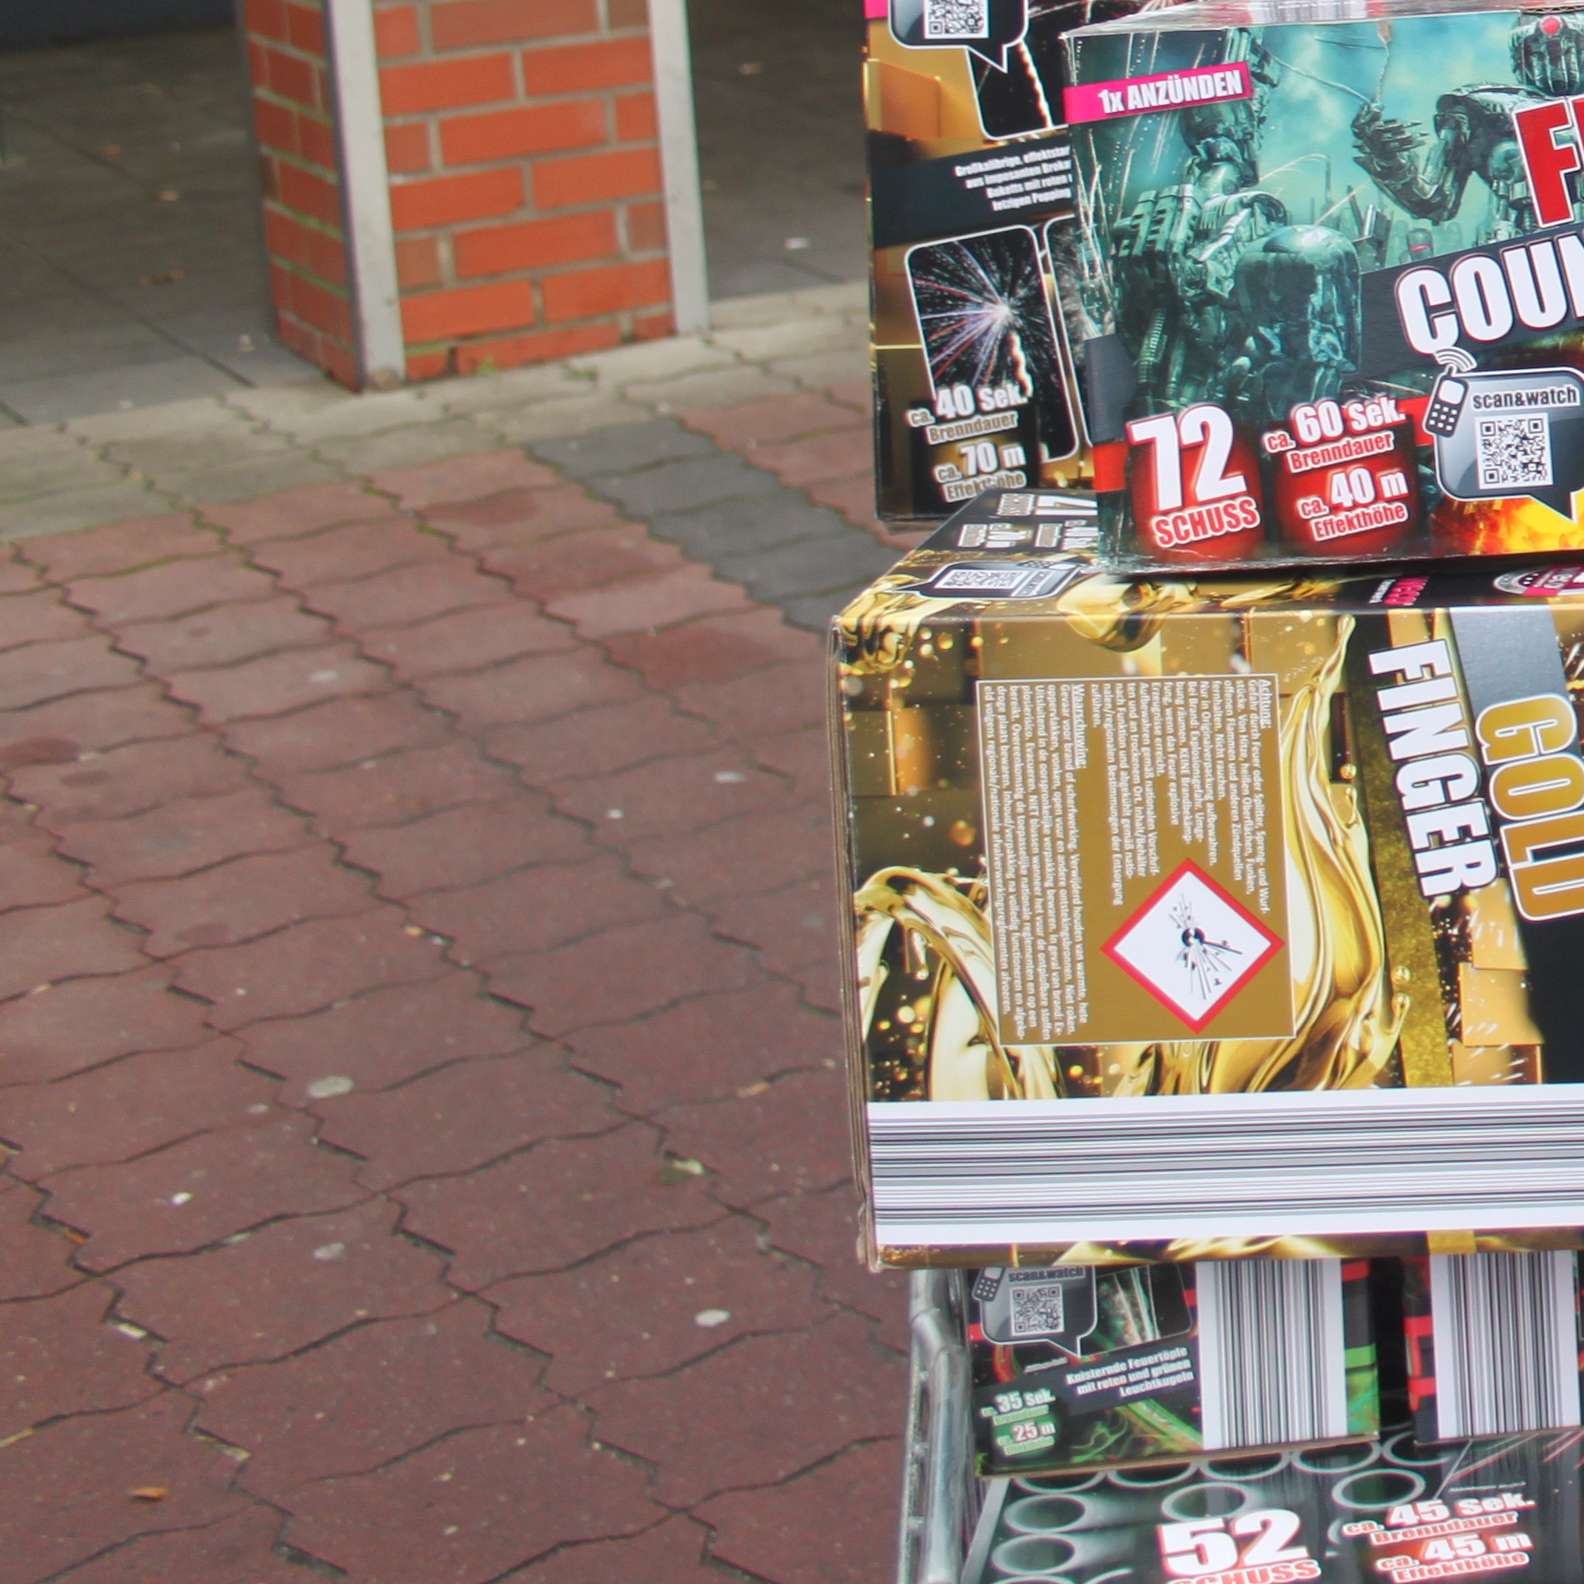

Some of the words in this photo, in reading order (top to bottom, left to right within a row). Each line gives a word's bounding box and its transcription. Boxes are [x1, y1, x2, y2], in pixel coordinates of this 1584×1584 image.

[1098, 87, 1124, 114] 1x
[1127, 70, 1243, 110] ANZÜNDEN
[907, 407, 935, 427] ca.
[935, 387, 975, 417] 40
[1472, 386, 1579, 409] scan&watch
[926, 410, 1018, 445] Brenndauer
[1264, 429, 1294, 453] ca.
[1295, 405, 1344, 444] 60
[1349, 396, 1406, 430] sek.
[935, 462, 963, 482] ca.
[960, 443, 998, 476] 70
[1129, 404, 1248, 513] 72
[1288, 430, 1396, 473] Brenndauer
[1298, 496, 1329, 517] ca.
[1330, 469, 1376, 508] 40
[1379, 469, 1409, 498] m
[1151, 498, 1261, 549] SCHUSS
[1311, 501, 1409, 542] Effekthöhe
[1260, 679, 1272, 729] Achtung:
[1367, 637, 1498, 899] FINGER
[994, 1391, 1021, 1412] 35
[1011, 1422, 1038, 1442] 25
[1342, 1521, 1385, 1537] ca.
[1386, 1499, 1450, 1527] 45
[1370, 1511, 1519, 1546] Brenndauer
[1157, 1510, 1310, 1579] 52
[1376, 1555, 1420, 1572] ca.
[1421, 1533, 1486, 1563] 45
[1492, 1533, 1535, 1553] m
[1391, 1551, 1530, 1584] Effekthöhe
